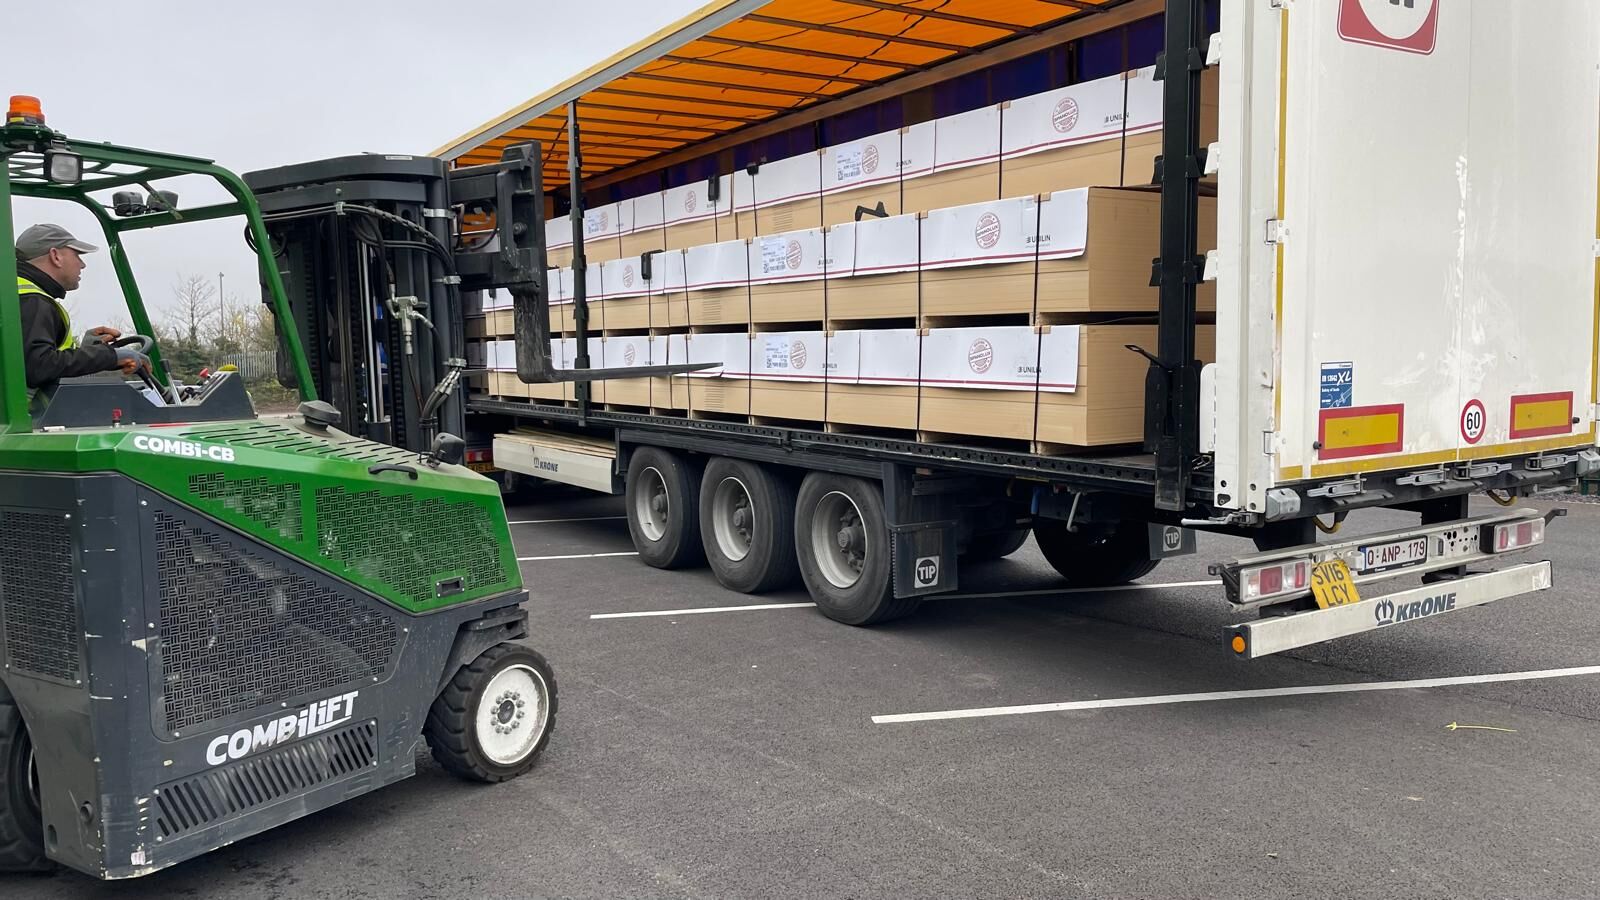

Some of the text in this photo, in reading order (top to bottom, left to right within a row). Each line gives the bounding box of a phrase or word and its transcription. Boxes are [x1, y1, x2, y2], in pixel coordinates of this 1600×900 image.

[1109, 112, 1129, 122] UNILN
[1032, 234, 1051, 243] UILIN
[1466, 411, 1481, 430] 60
[540, 461, 559, 472] KRONE
[1165, 532, 1179, 545] TIP
[918, 565, 936, 580] TIP
[1312, 563, 1345, 585] SV16
[1321, 583, 1351, 607] LCY
[1396, 592, 1457, 622] KRONE
